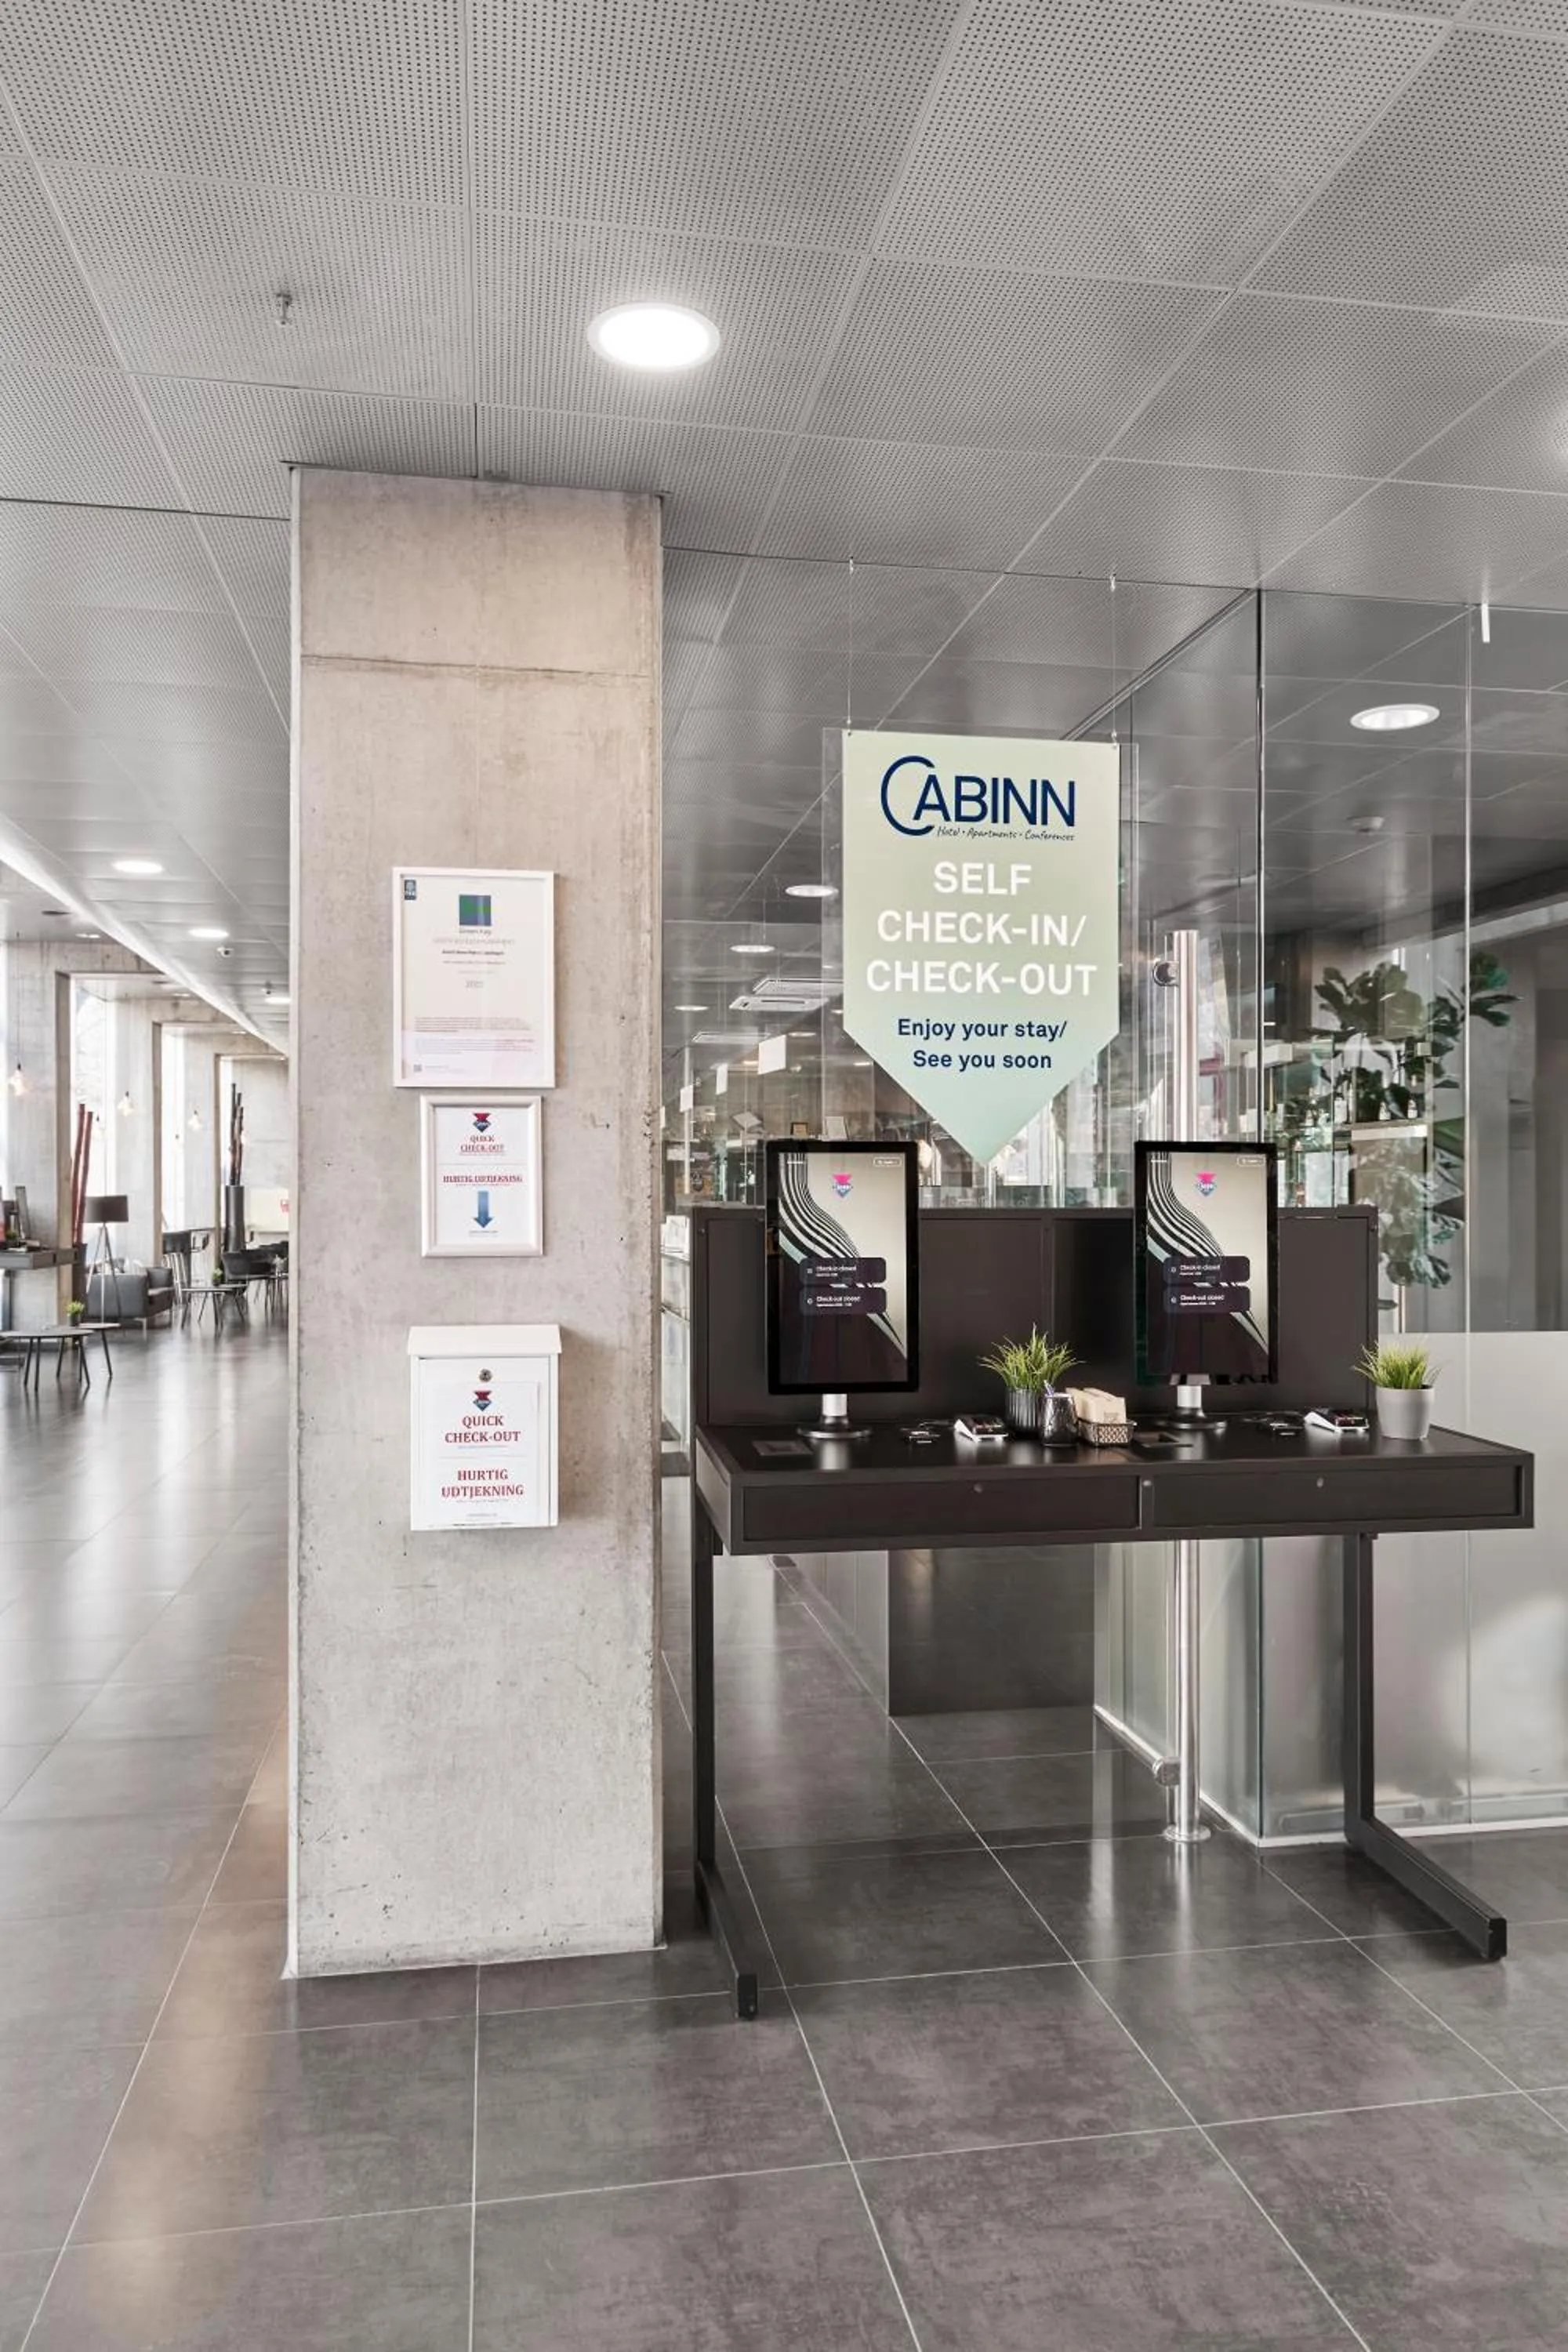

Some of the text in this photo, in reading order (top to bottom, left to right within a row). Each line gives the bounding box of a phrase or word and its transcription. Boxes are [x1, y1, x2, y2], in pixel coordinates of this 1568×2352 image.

[880, 756, 1076, 836] CABINN
[937, 826, 1076, 841] Hotel Apartments Conferences
[933, 861, 1032, 895] SELF
[877, 910, 1087, 946] CHECK-IN/
[866, 960, 1098, 996] CHECK-OUT
[898, 1018, 1067, 1040] Enjoy your stay/
[913, 1050, 1051, 1073] See you soon
[462, 1415, 504, 1428] QUICK
[445, 1431, 521, 1443] CHECK-OUT
[457, 1468, 509, 1481] HURTIG
[441, 1484, 524, 1499] UDTJEKNING
